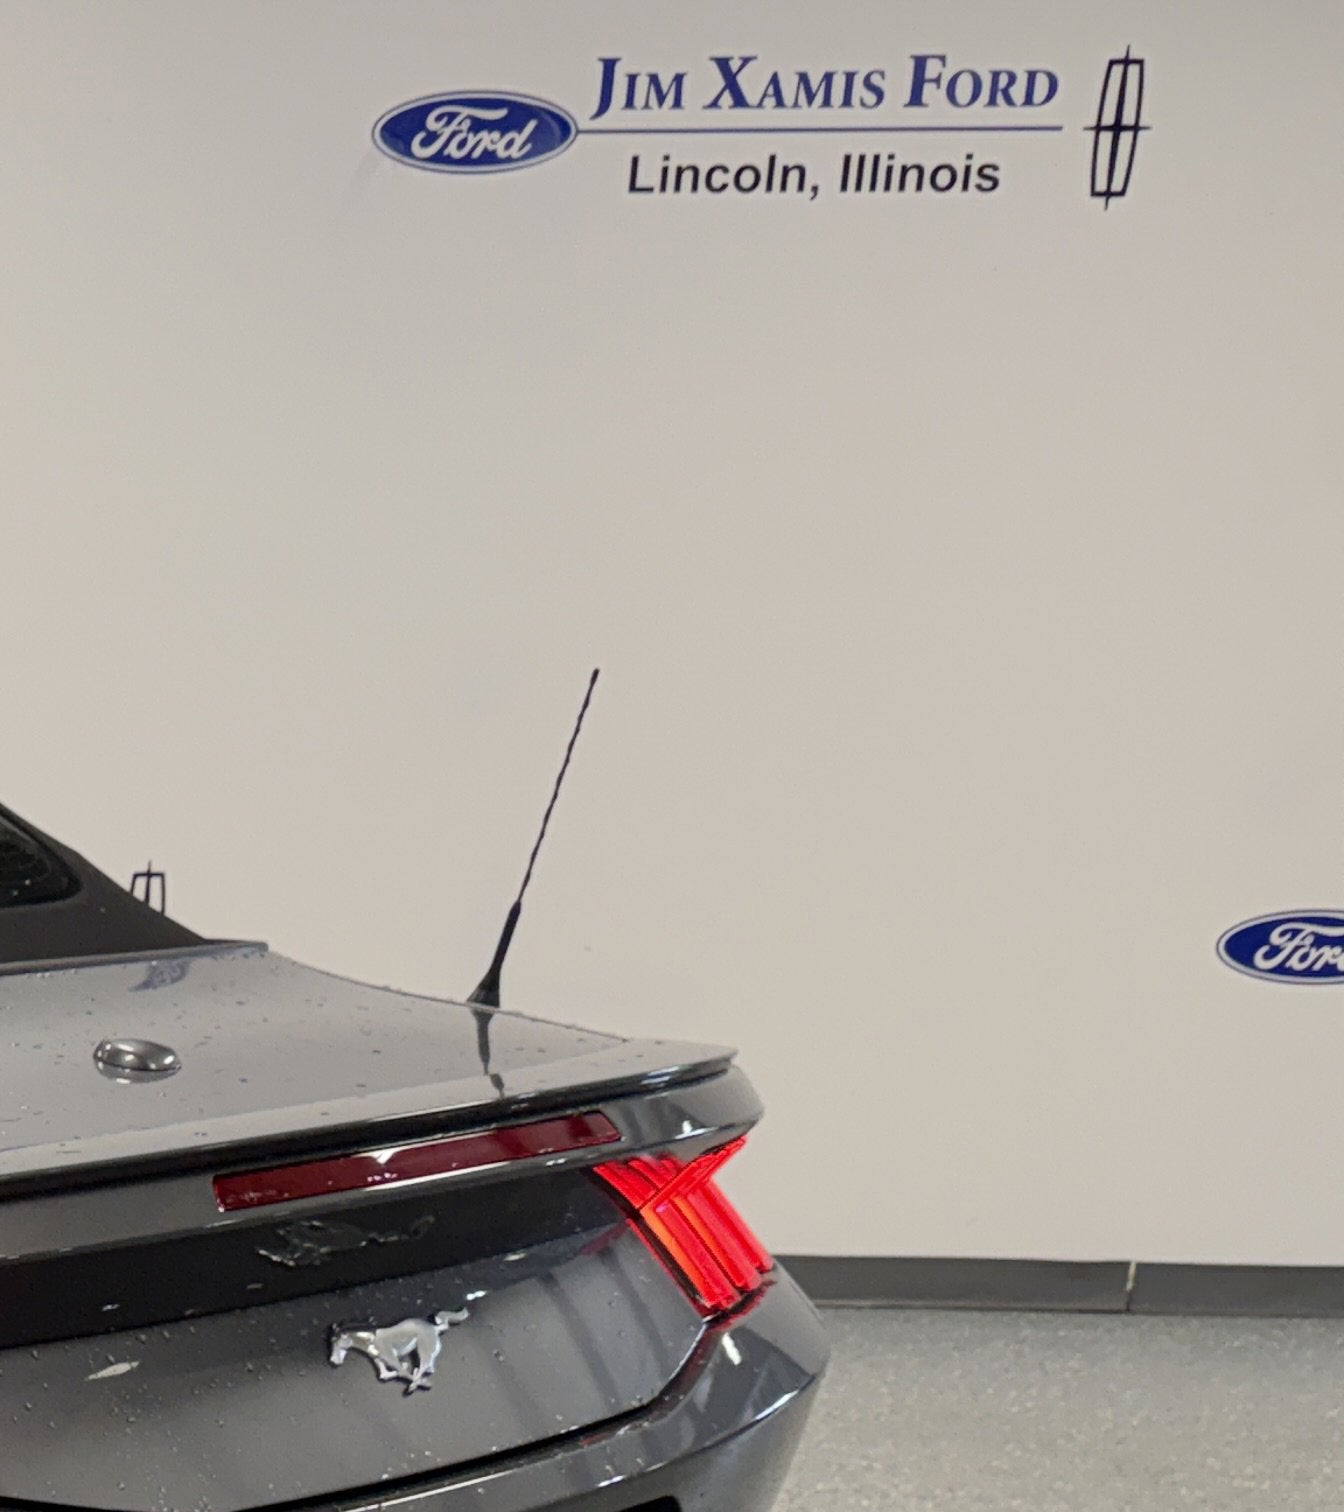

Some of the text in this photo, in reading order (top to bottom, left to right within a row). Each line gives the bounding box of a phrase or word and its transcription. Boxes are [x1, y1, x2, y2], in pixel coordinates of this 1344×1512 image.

[588, 54, 1060, 120] JIM XAMIS FORD
[410, 104, 539, 160] Ford
[628, 153, 1001, 201] Lincoln, Illinois
